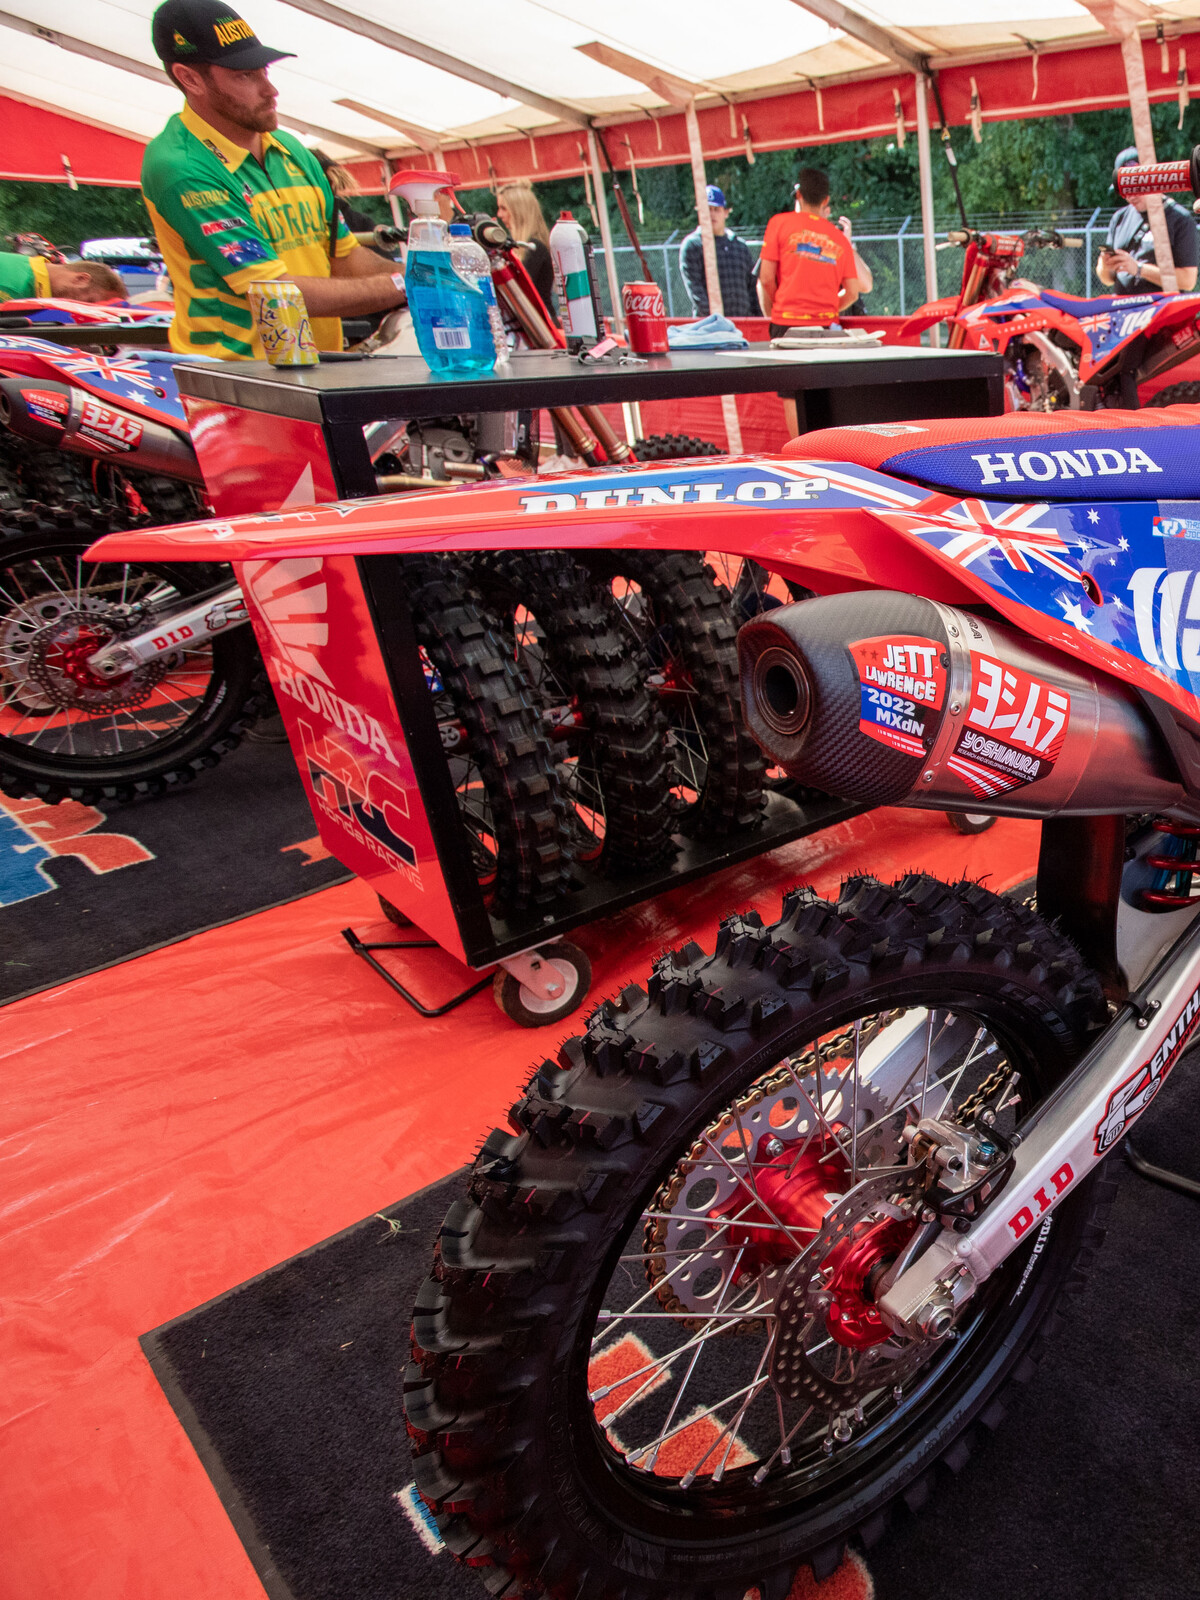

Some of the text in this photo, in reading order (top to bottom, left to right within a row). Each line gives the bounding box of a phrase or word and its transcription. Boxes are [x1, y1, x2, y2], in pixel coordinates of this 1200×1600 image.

[213, 18, 256, 48] AUSTR
[1120, 172, 1187, 185] RENTHAL
[1121, 162, 1189, 174] RENTHAL
[1122, 183, 1187, 195] RENTHAL
[622, 289, 666, 316] Coca-C
[1111, 295, 1154, 306] HONDA
[998, 319, 1048, 334] LAWRENCE
[1119, 307, 1157, 338] 114
[971, 447, 1163, 485] HONDA
[519, 477, 831, 514] DUNLOP
[882, 644, 938, 678] JETT
[865, 666, 937, 702] LAWRENCE
[270, 656, 400, 767] HONDA
[867, 688, 917, 717] 2022
[960, 731, 1041, 776] YOSHIMURA
